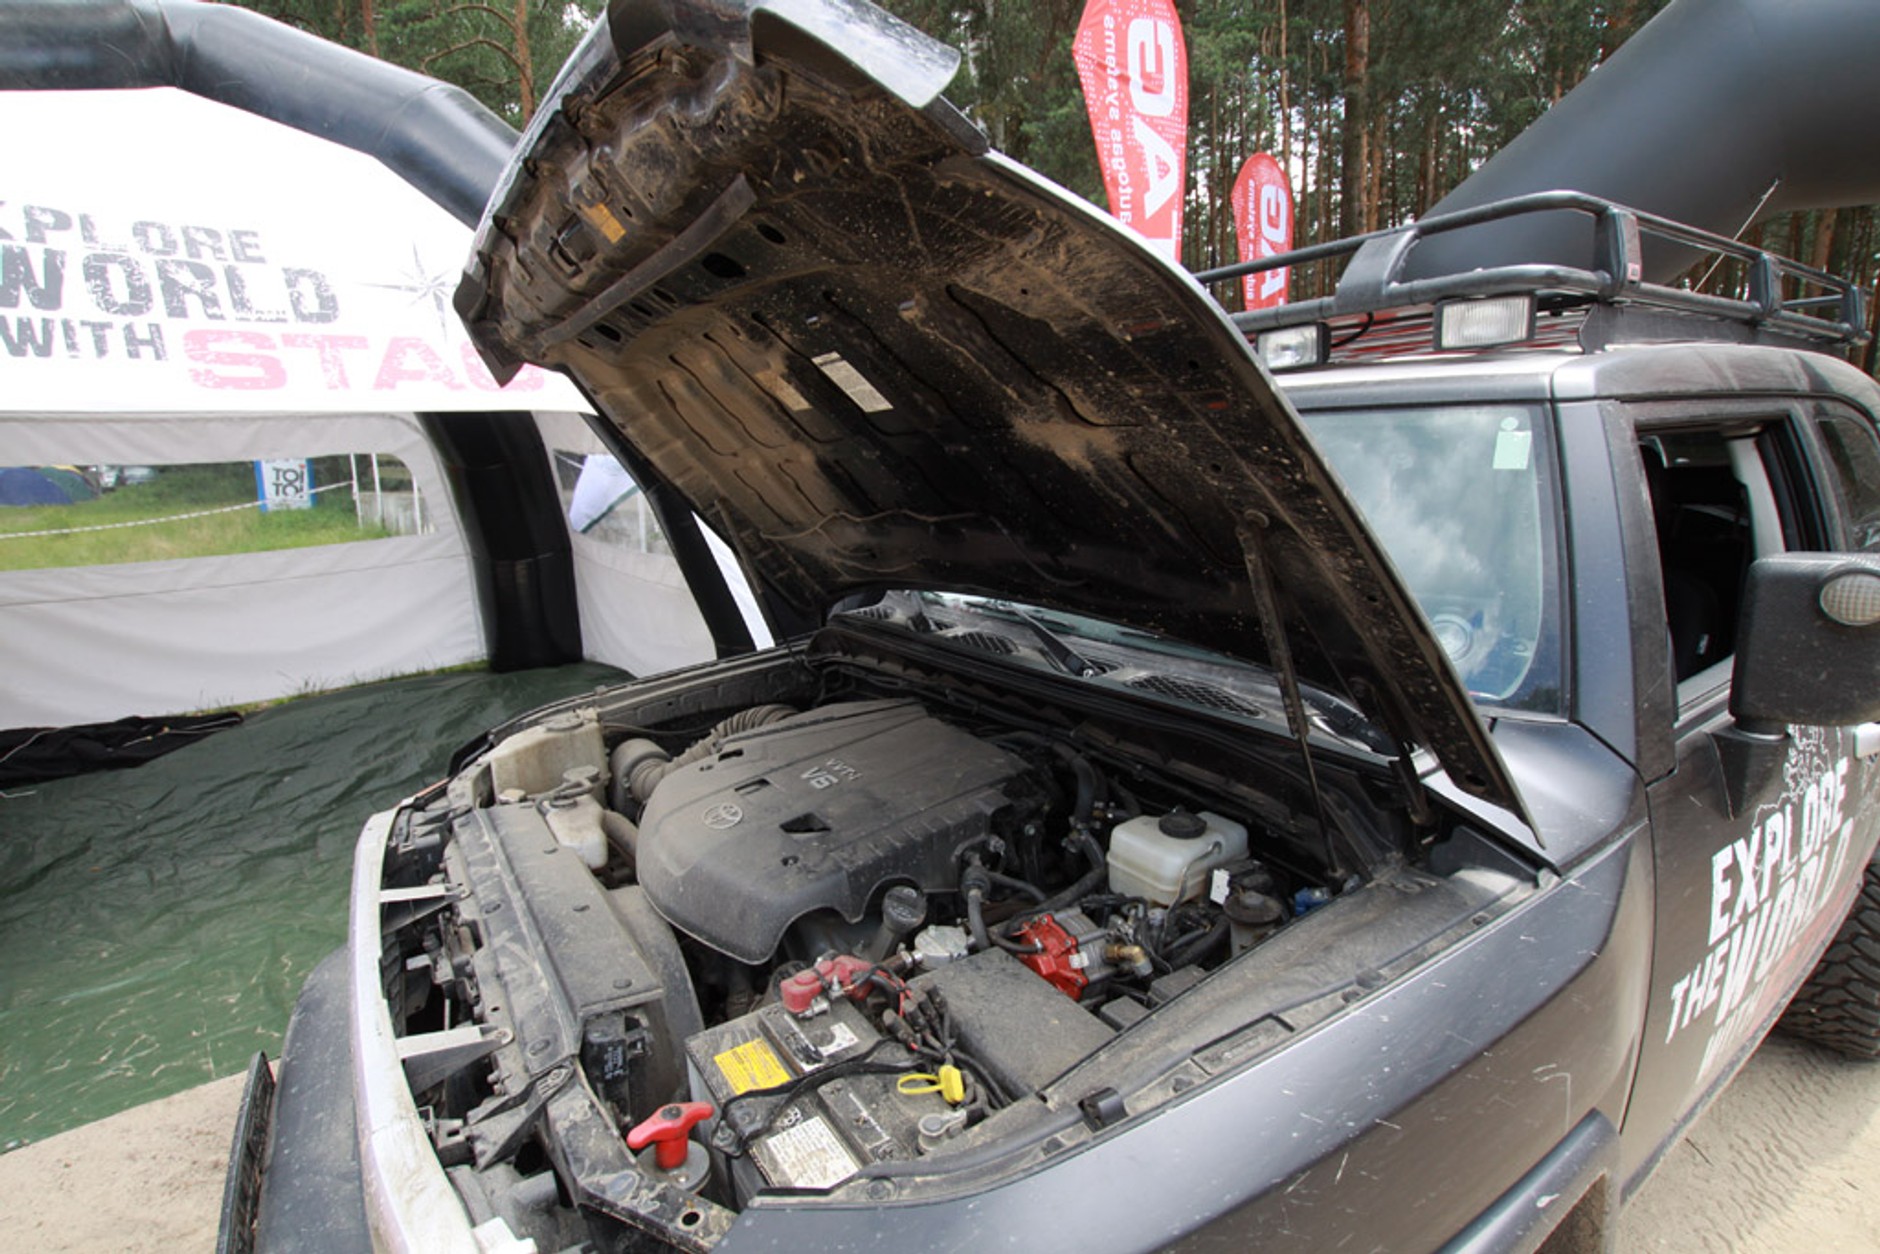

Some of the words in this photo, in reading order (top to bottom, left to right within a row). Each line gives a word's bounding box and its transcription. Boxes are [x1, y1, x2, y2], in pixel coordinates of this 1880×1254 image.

[0, 314, 168, 361] WITH
[801, 766, 838, 789] V6
[1707, 756, 1848, 946] EXPLORE
[1664, 938, 1730, 1045] THE
